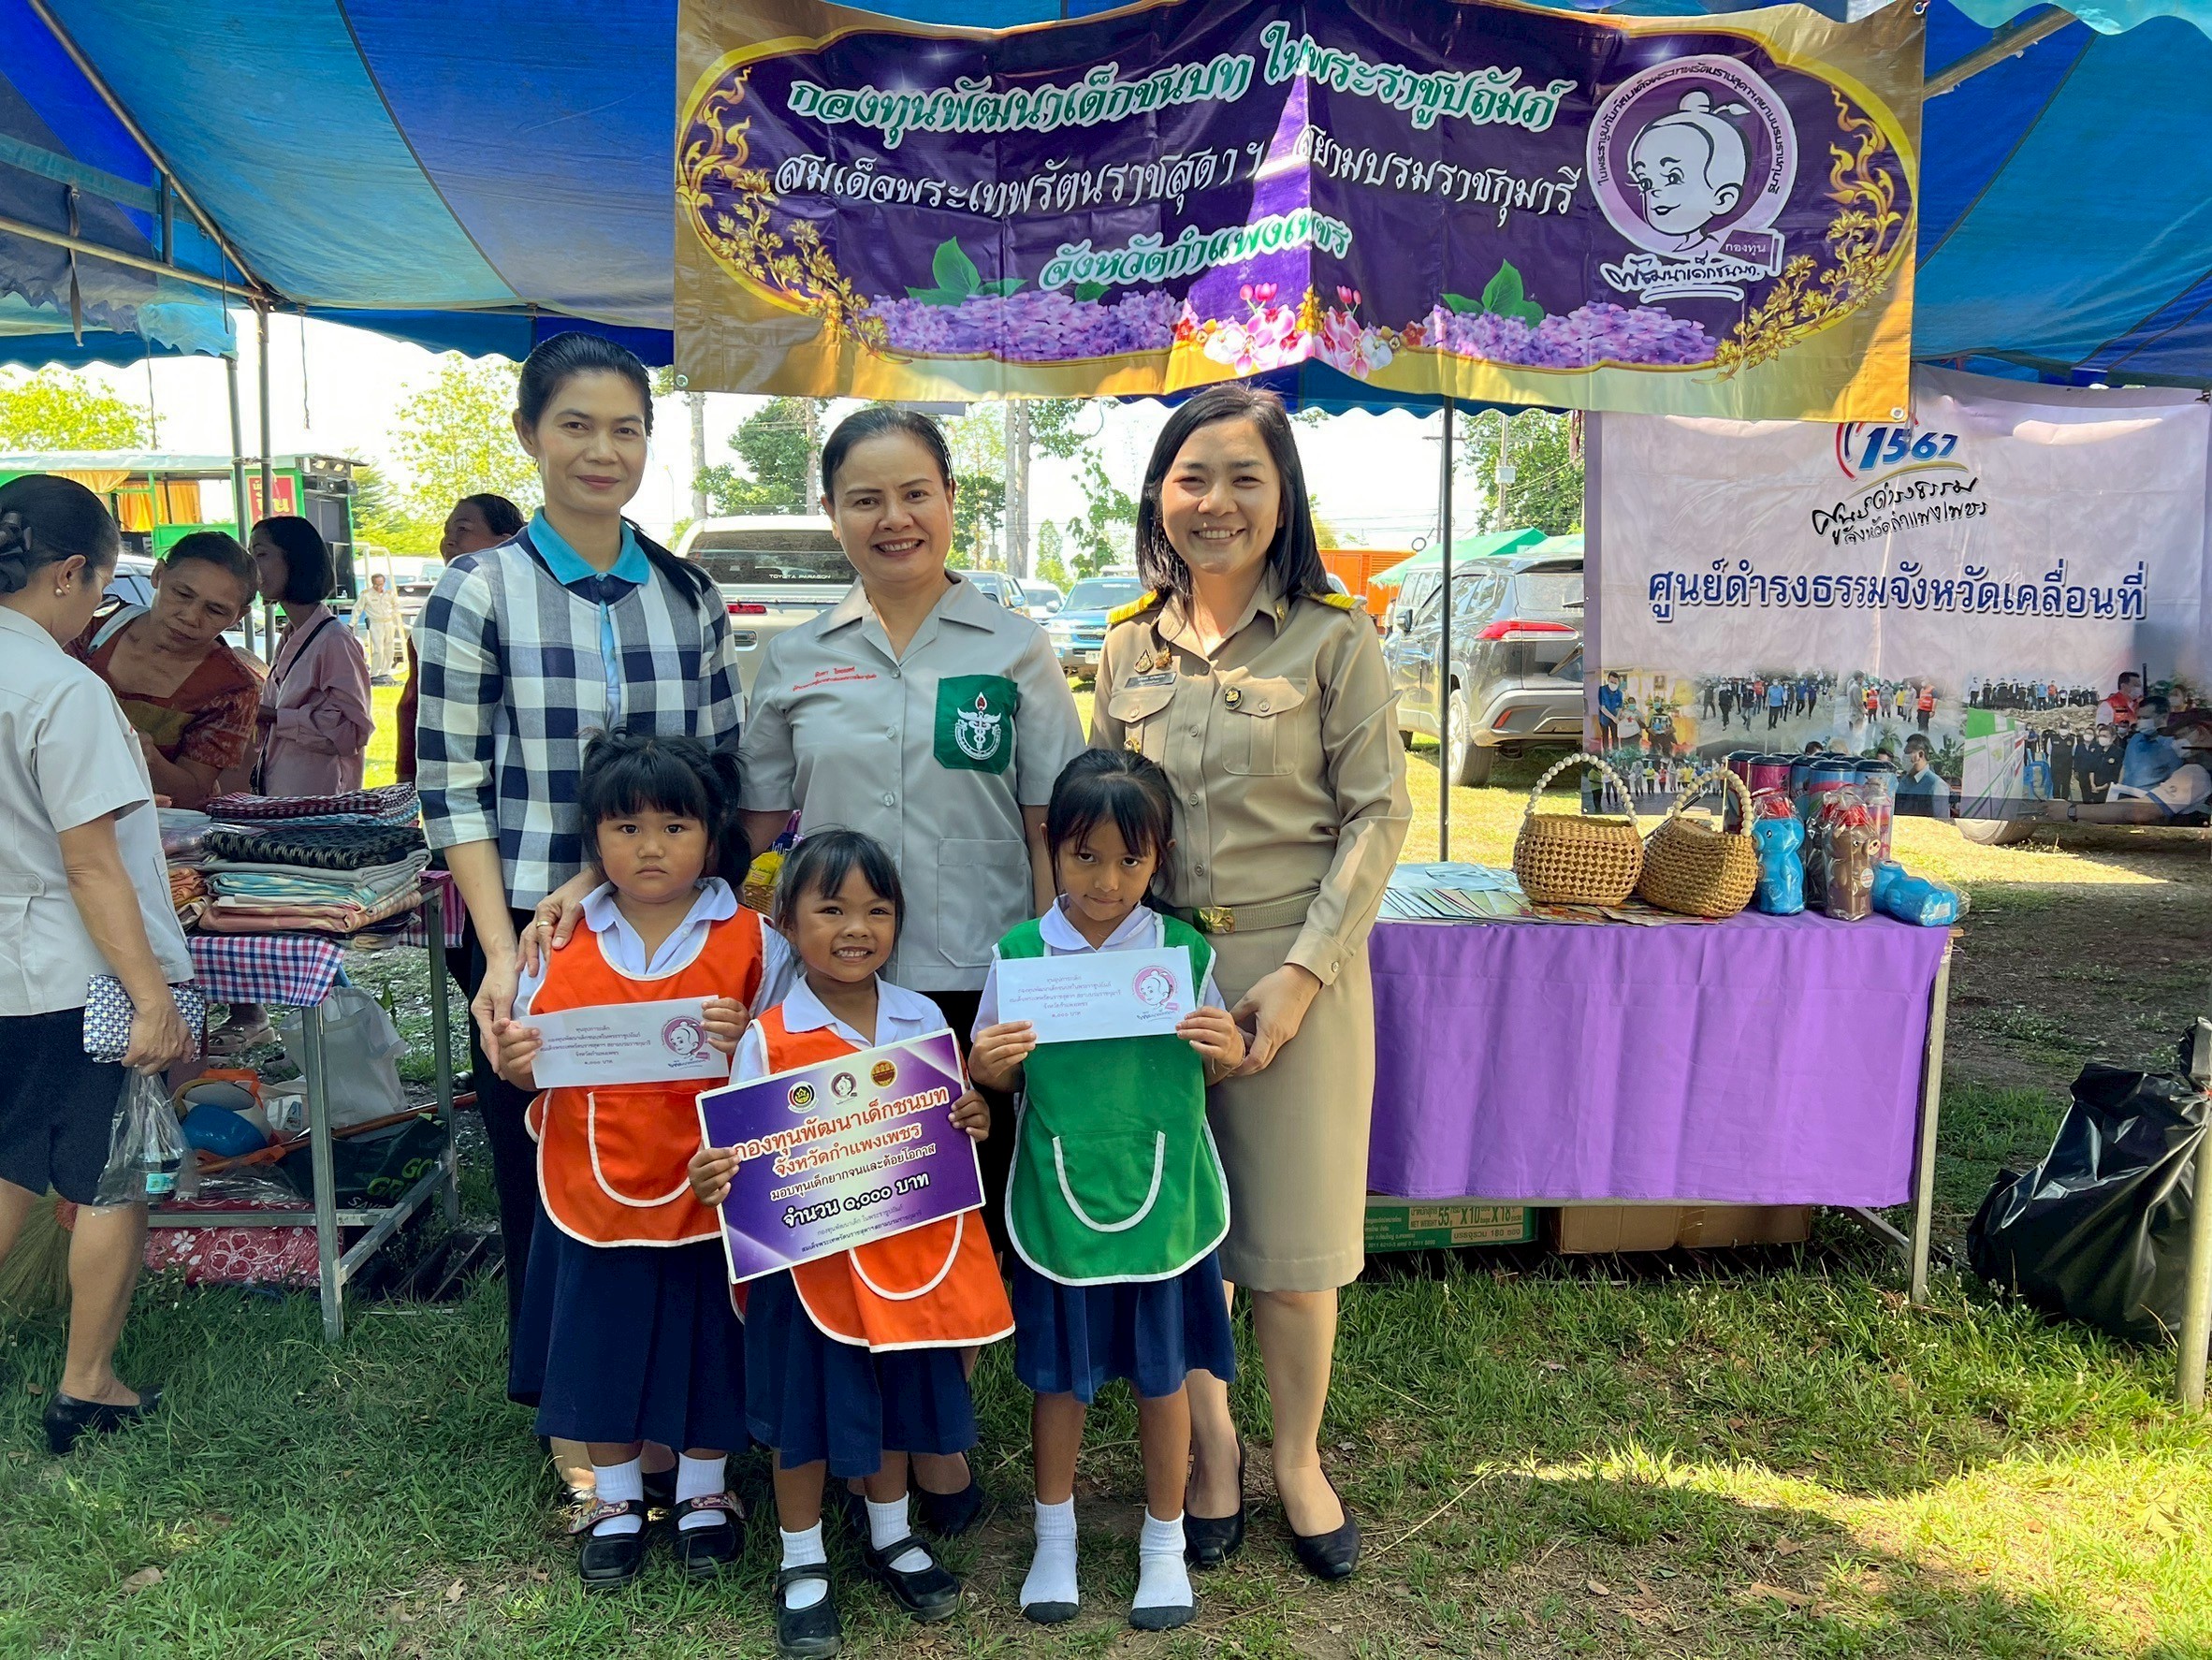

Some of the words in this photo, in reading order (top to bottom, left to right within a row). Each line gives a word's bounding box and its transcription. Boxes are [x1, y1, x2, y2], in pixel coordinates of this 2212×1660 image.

[788, 53, 1255, 149] กองทุนพัฒนาเด็กชนบท
[1260, 21, 1577, 132] ในพระราชูปถัมภ์
[1292, 124, 1581, 227] สยามบรมราชกุมารี
[1039, 207, 1352, 292] จังหวัดกำแพงเพชร
[1724, 241, 1767, 255] กองทุน
[1857, 426, 1958, 471] 1567
[1812, 476, 1979, 546] ศูนย์ดำรงธรรม
[1648, 558, 2147, 621] ศูนย์ดำรงธรรมจังหวัดเคลื่อนที่
[735, 1086, 950, 1158] กองทุนพัฒนาเด็กชนบท
[774, 1123, 922, 1177] จังหวัดกำแพงเพชร
[782, 1199, 839, 1228] จำนวน
[895, 1172, 930, 1195] บาท
